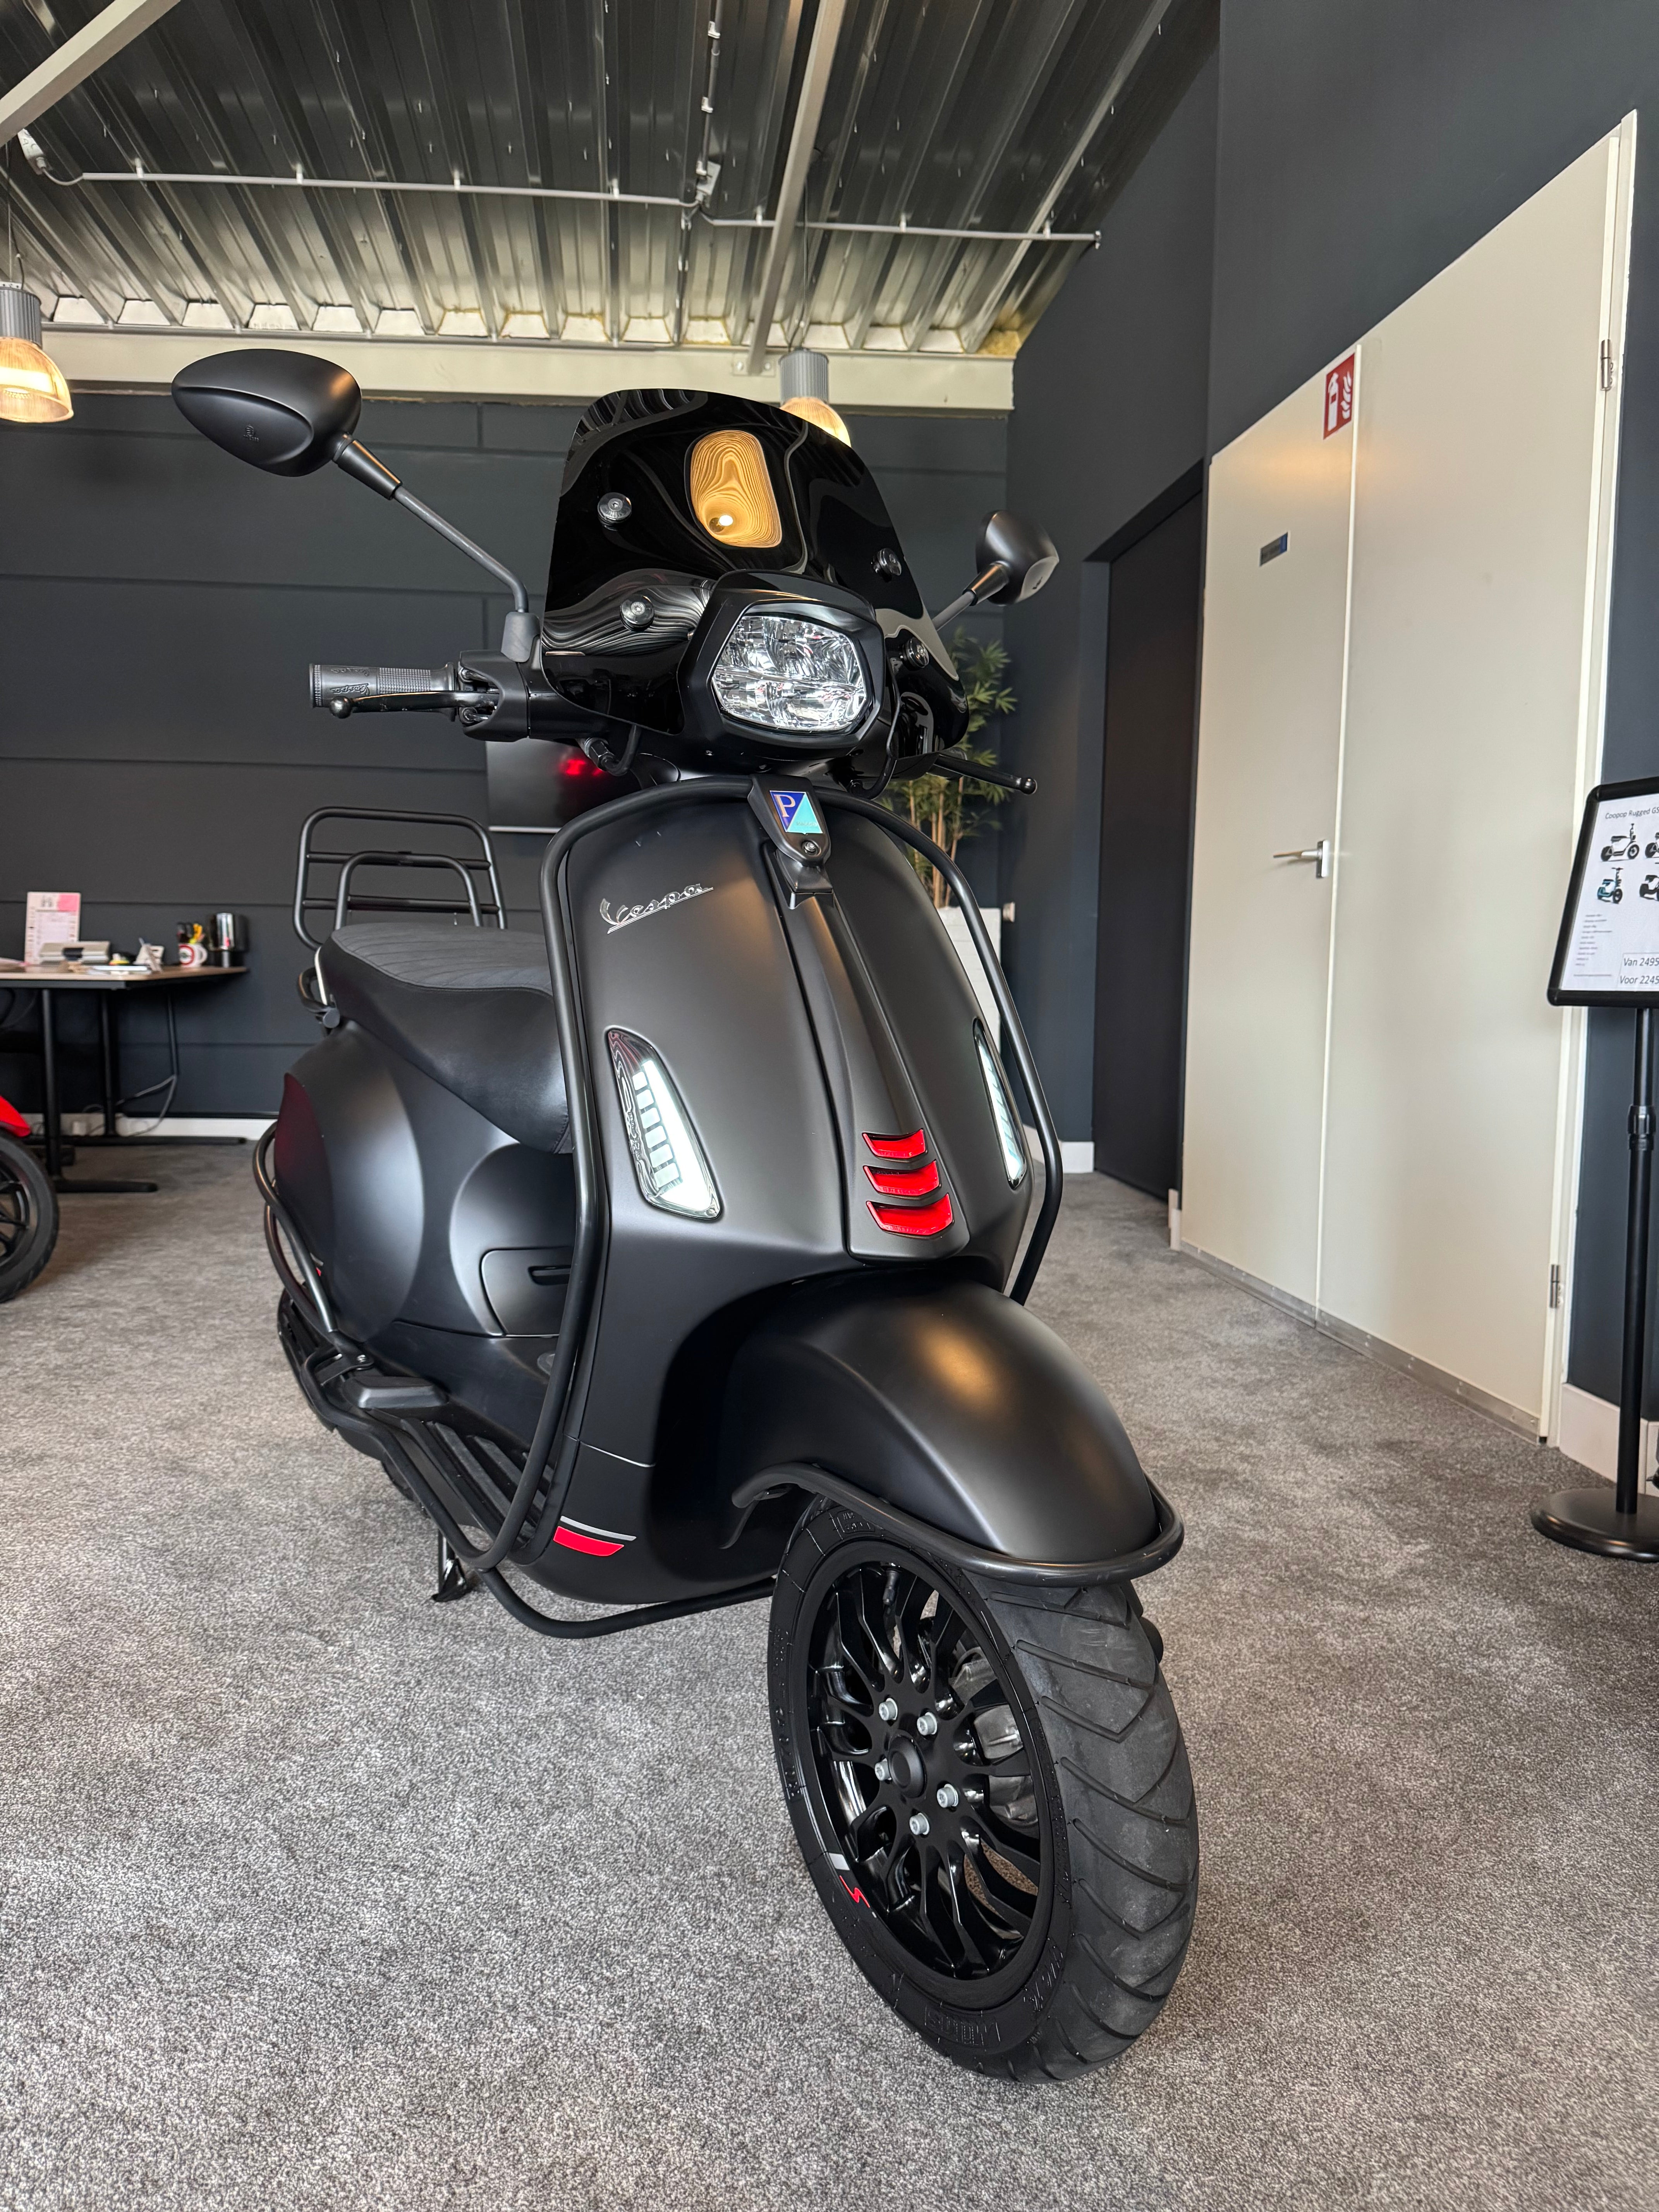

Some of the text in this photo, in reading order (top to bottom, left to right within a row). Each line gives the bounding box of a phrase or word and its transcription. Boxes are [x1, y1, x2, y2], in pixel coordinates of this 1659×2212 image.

[773, 794, 796, 817] P
[1628, 808, 1650, 817] Rugged
[600, 883, 713, 934] Vespa
[1624, 957, 1659, 966] Van 2495
[1620, 975, 1659, 984] Voor 2245
